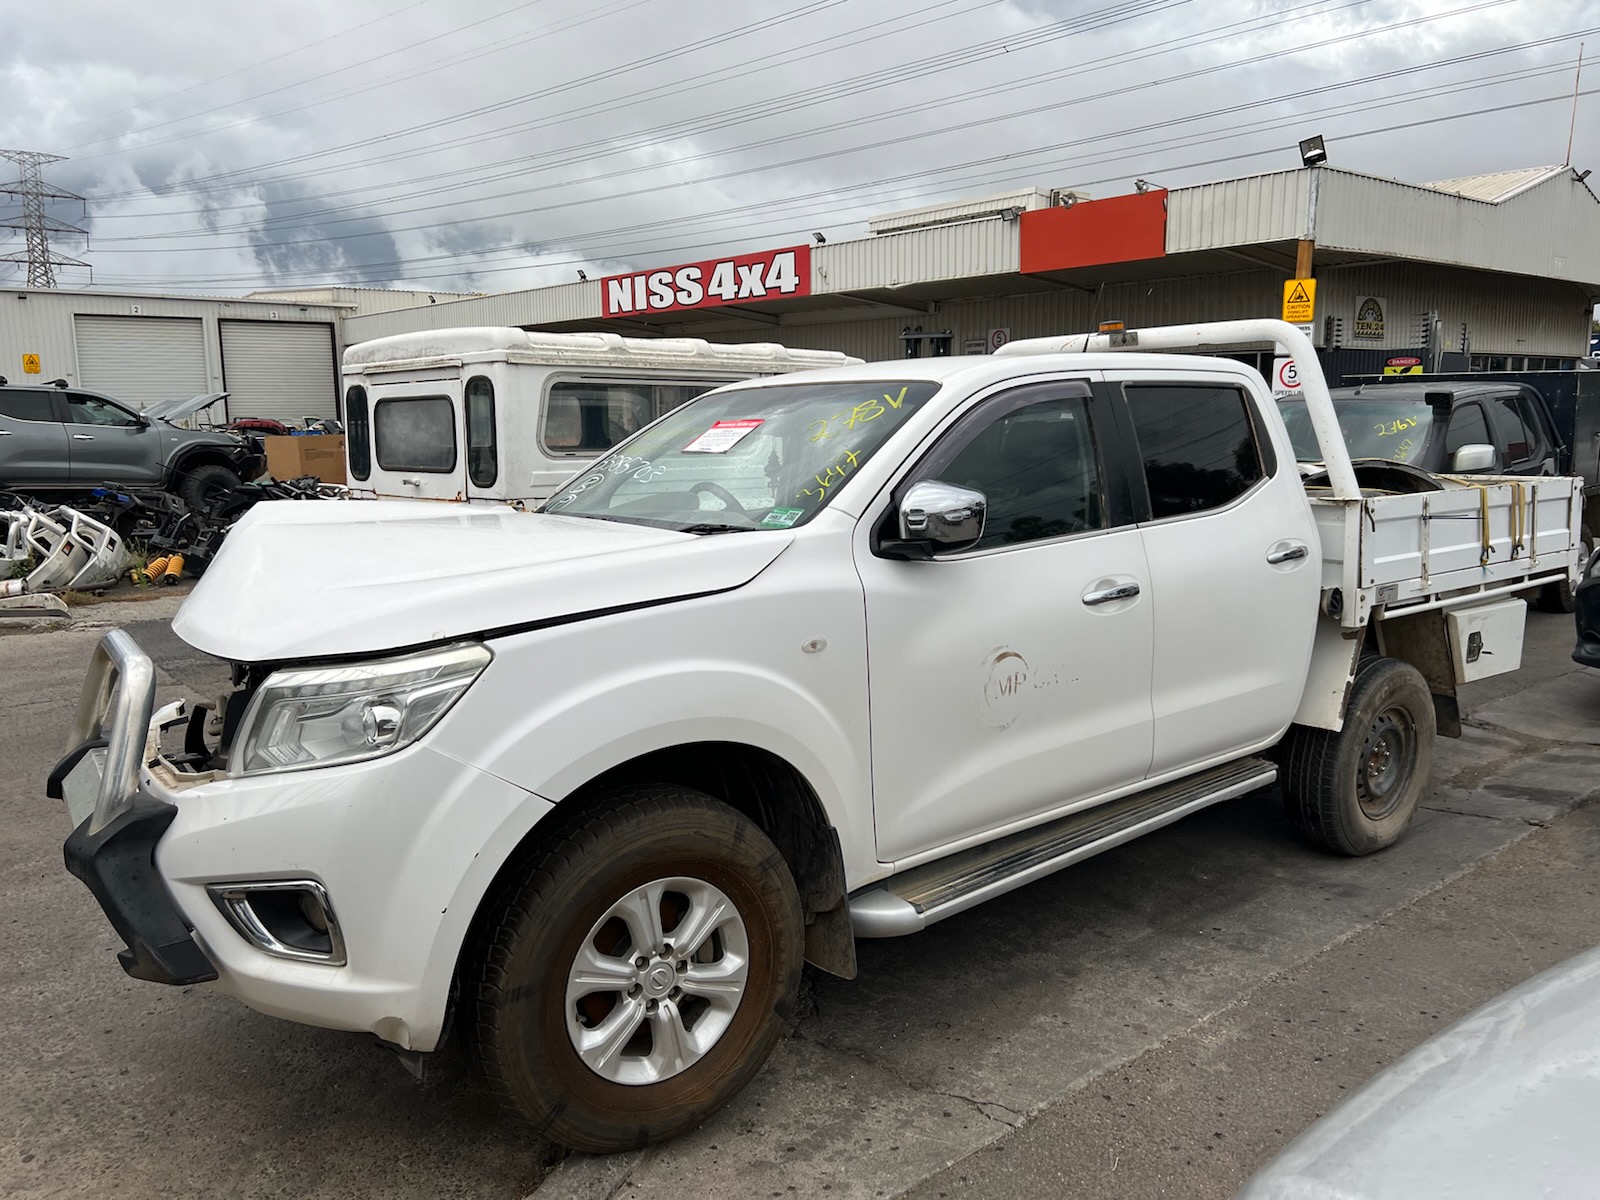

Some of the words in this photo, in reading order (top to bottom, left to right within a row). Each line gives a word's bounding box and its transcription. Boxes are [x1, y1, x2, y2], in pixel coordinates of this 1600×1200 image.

[607, 266, 704, 315] NISS
[708, 251, 800, 302] 4x4
[1355, 321, 1384, 331] TEN.24
[996, 333, 1002, 343] 5
[1287, 365, 1298, 379] 5
[998, 671, 1027, 697] MP
